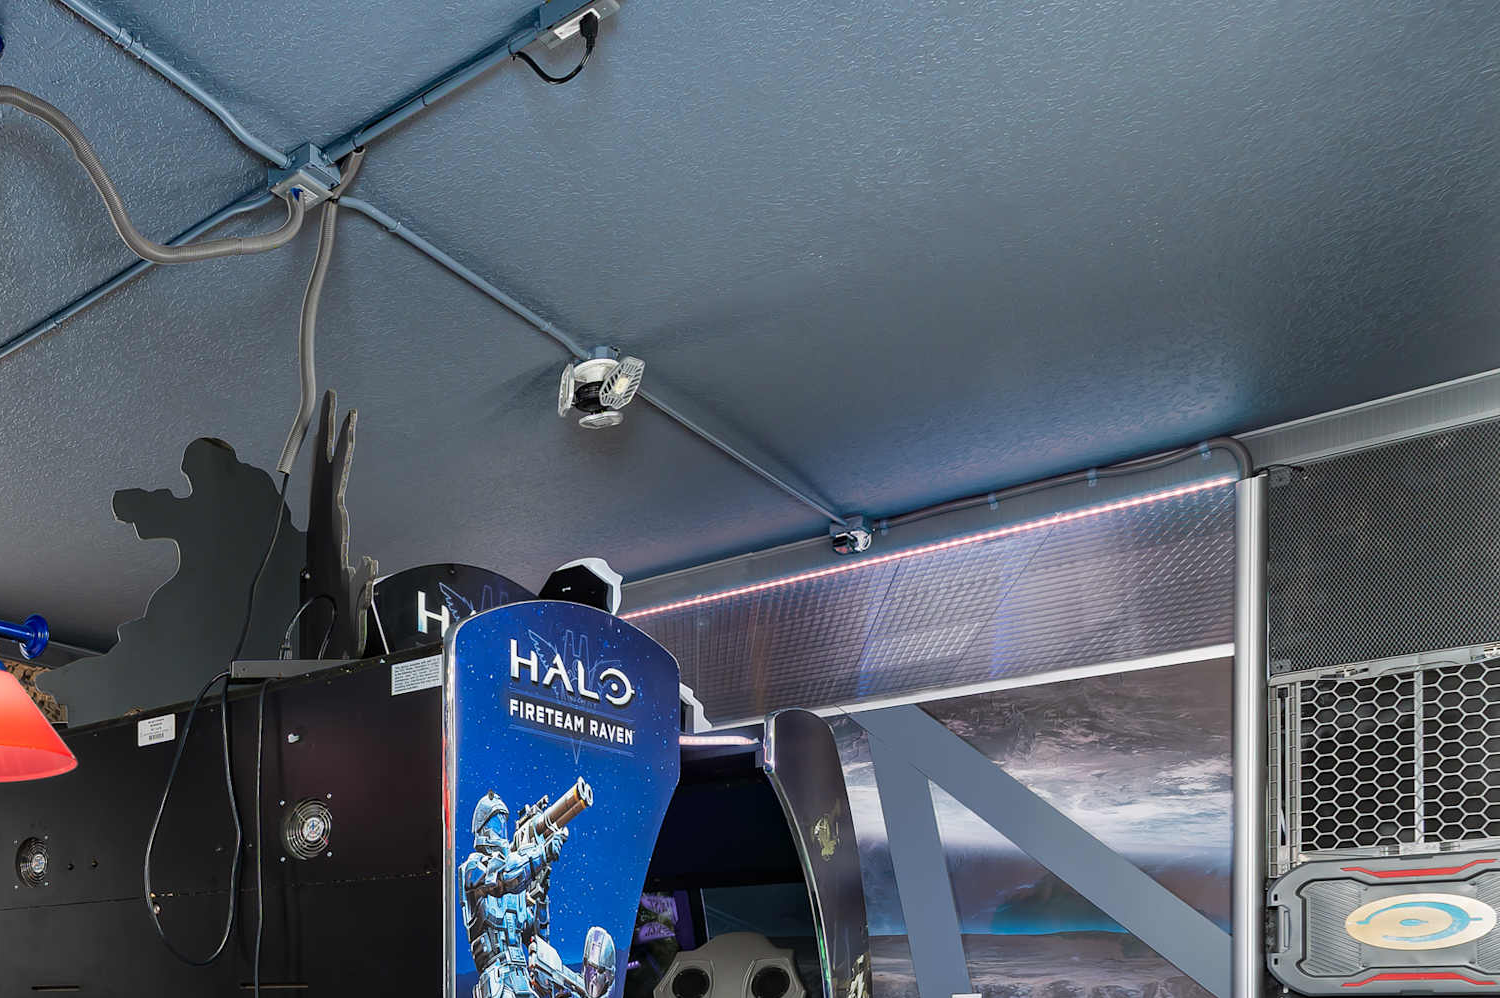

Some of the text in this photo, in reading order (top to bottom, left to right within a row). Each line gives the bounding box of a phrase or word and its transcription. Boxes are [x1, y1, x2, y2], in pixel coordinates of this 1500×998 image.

[509, 638, 635, 705] HALO
[509, 698, 635, 746] FIRETEAM RAVEN
